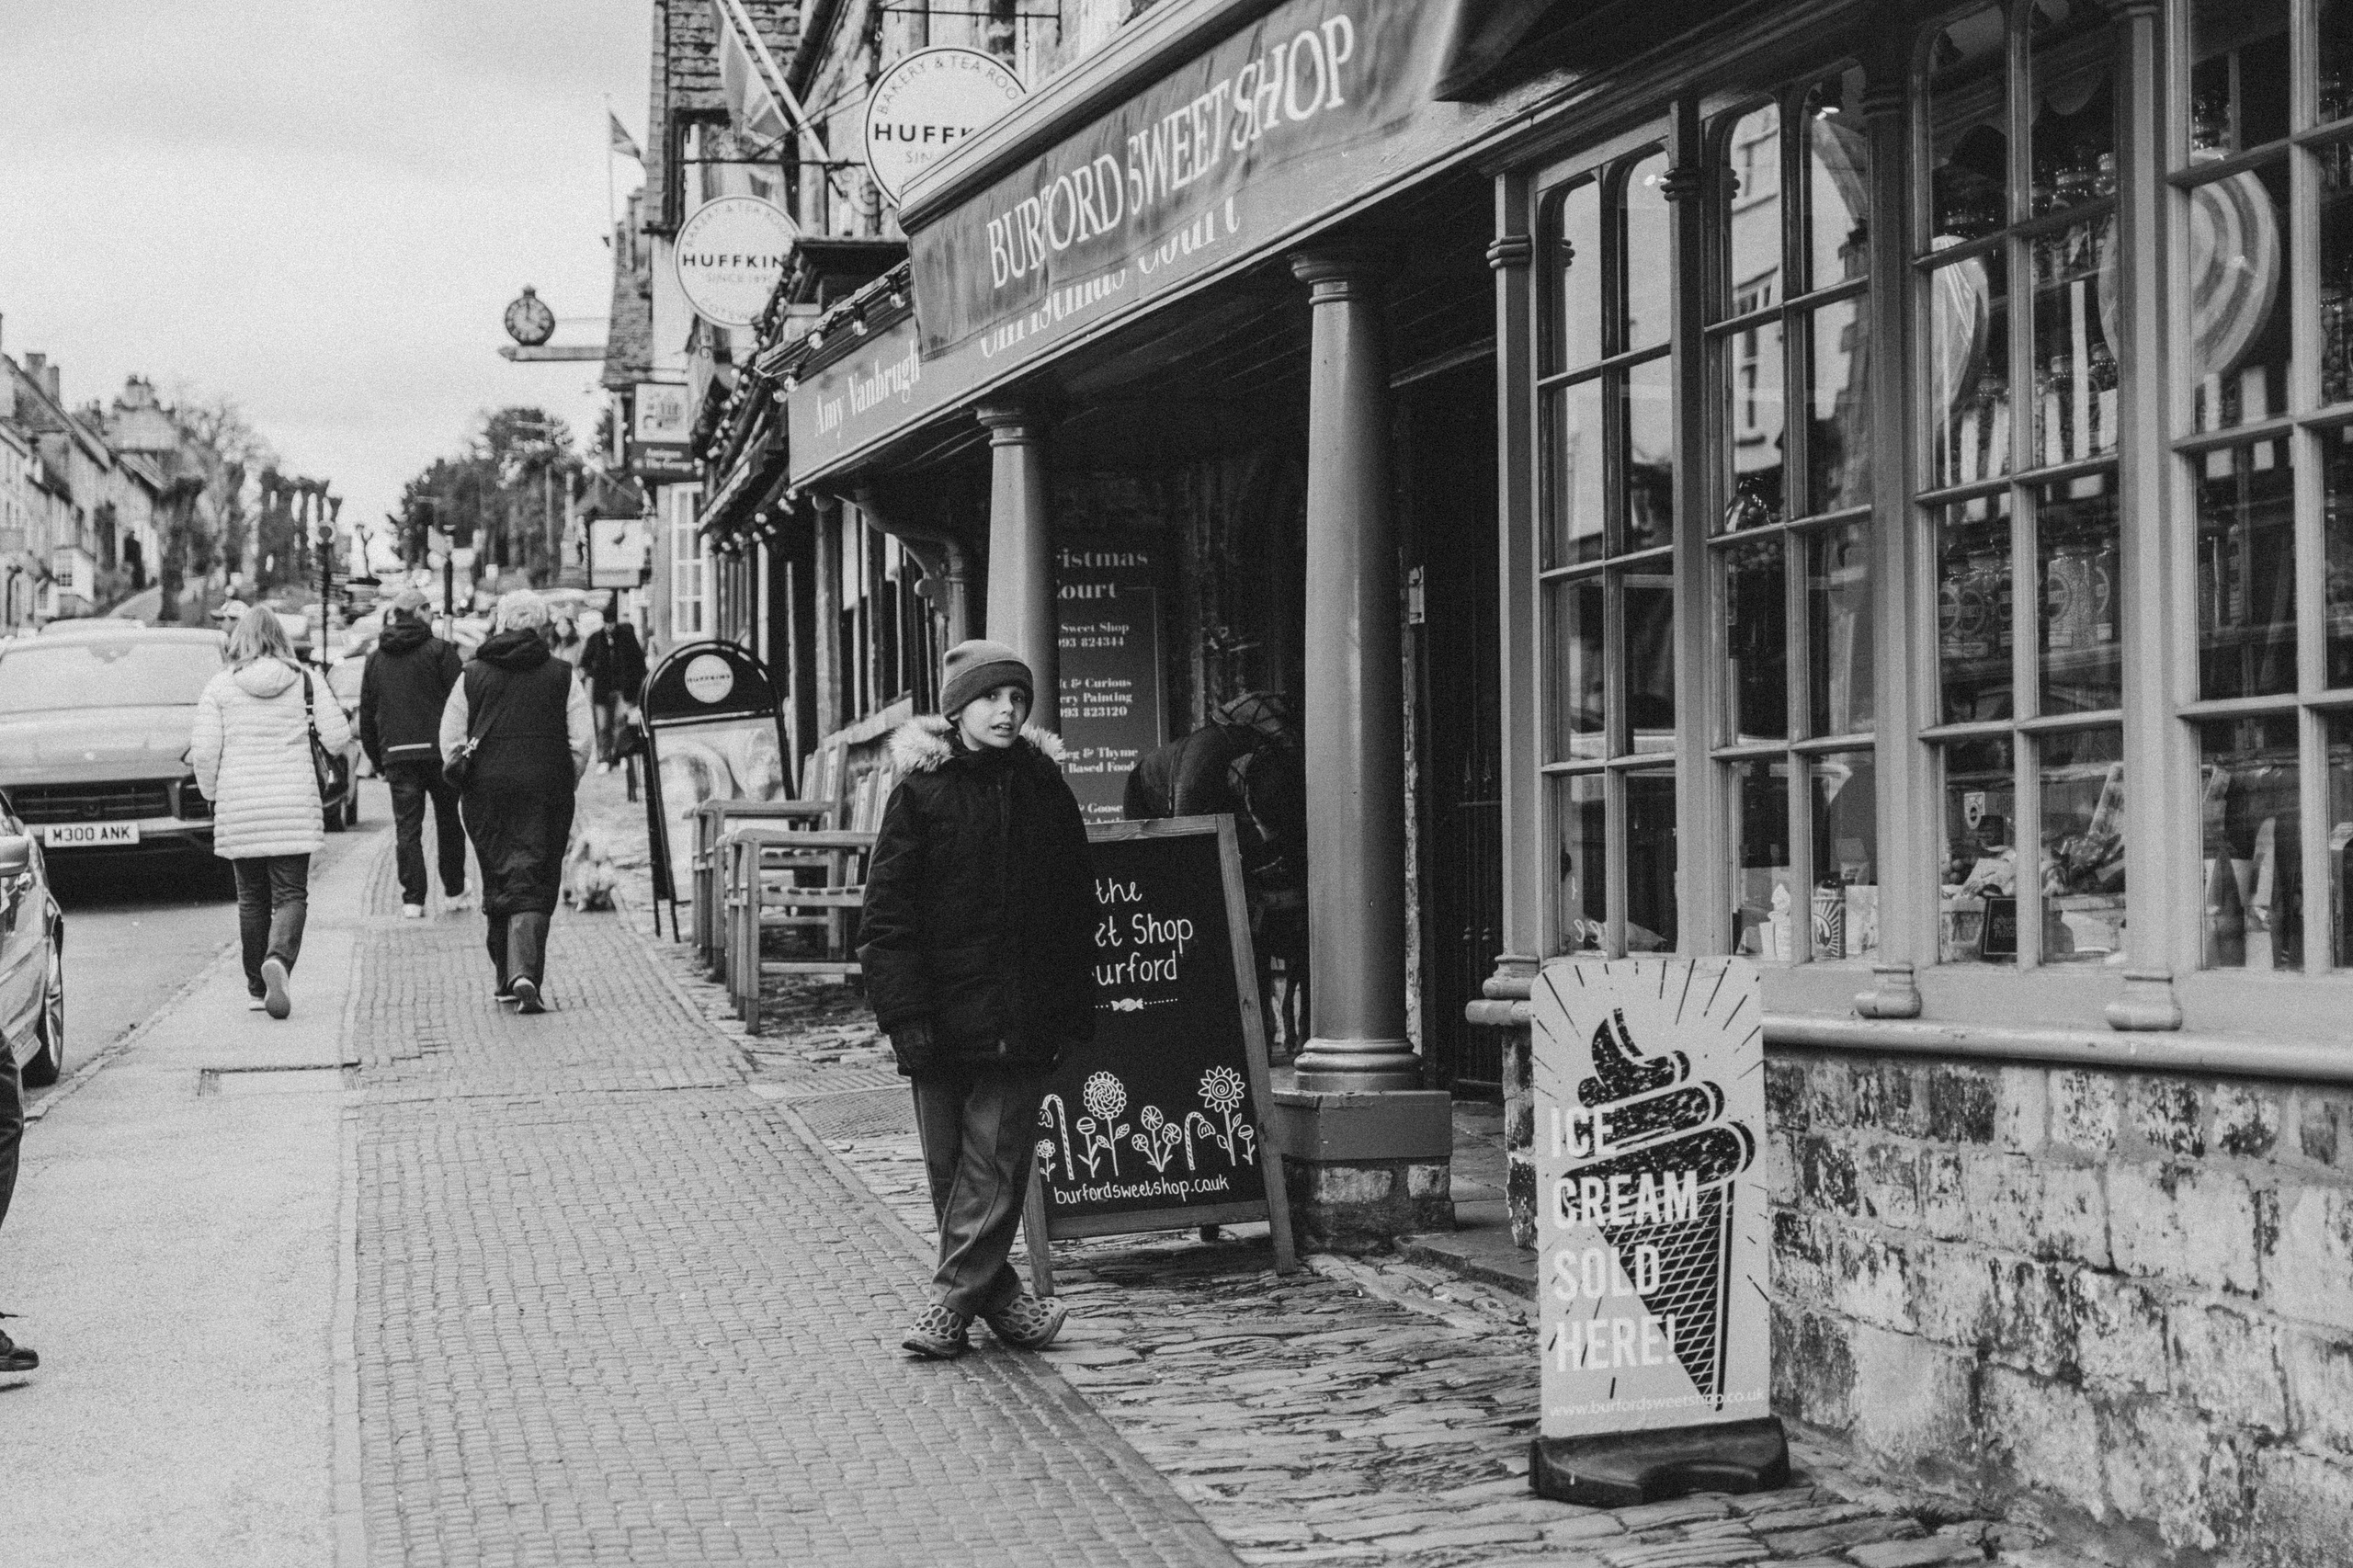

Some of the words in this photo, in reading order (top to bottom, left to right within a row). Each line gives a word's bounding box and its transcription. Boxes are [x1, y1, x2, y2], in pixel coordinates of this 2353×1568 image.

[877, 61, 926, 115] BAKERY
[934, 56, 944, 69] &
[950, 55, 981, 71] TEA
[986, 68, 1019, 100] ROO
[905, 151, 933, 164] SIN
[986, 154, 1123, 290] BURFORD
[1129, 78, 1231, 214] SWEET
[1233, 14, 1354, 153] SHOP
[683, 255, 782, 268] HUFFKIN
[848, 339, 921, 417] Vanbrugh
[1056, 548, 1148, 568] istmas
[1060, 623, 1095, 633] Sweet
[1099, 621, 1130, 634] Shop
[1085, 677, 1131, 687] Curious
[1083, 692, 1133, 703] Painting
[1083, 707, 1128, 717] 823120
[1097, 747, 1139, 760] Thyme
[1068, 761, 1104, 773] Based
[1107, 761, 1136, 772] Food
[52, 827, 95, 842] M300
[100, 826, 131, 840] ANK
[1095, 878, 1142, 904] the
[1094, 915, 1123, 949] et
[1132, 913, 1194, 956] Shop
[1092, 949, 1178, 987] urford
[1551, 1104, 1618, 1159] ICE
[1053, 1174, 1231, 1204] burfordsweetshop.co.uk
[1552, 1169, 1699, 1231] CREAM
[1553, 1244, 1661, 1302] SOLD
[1555, 1313, 1677, 1374] HERE!
